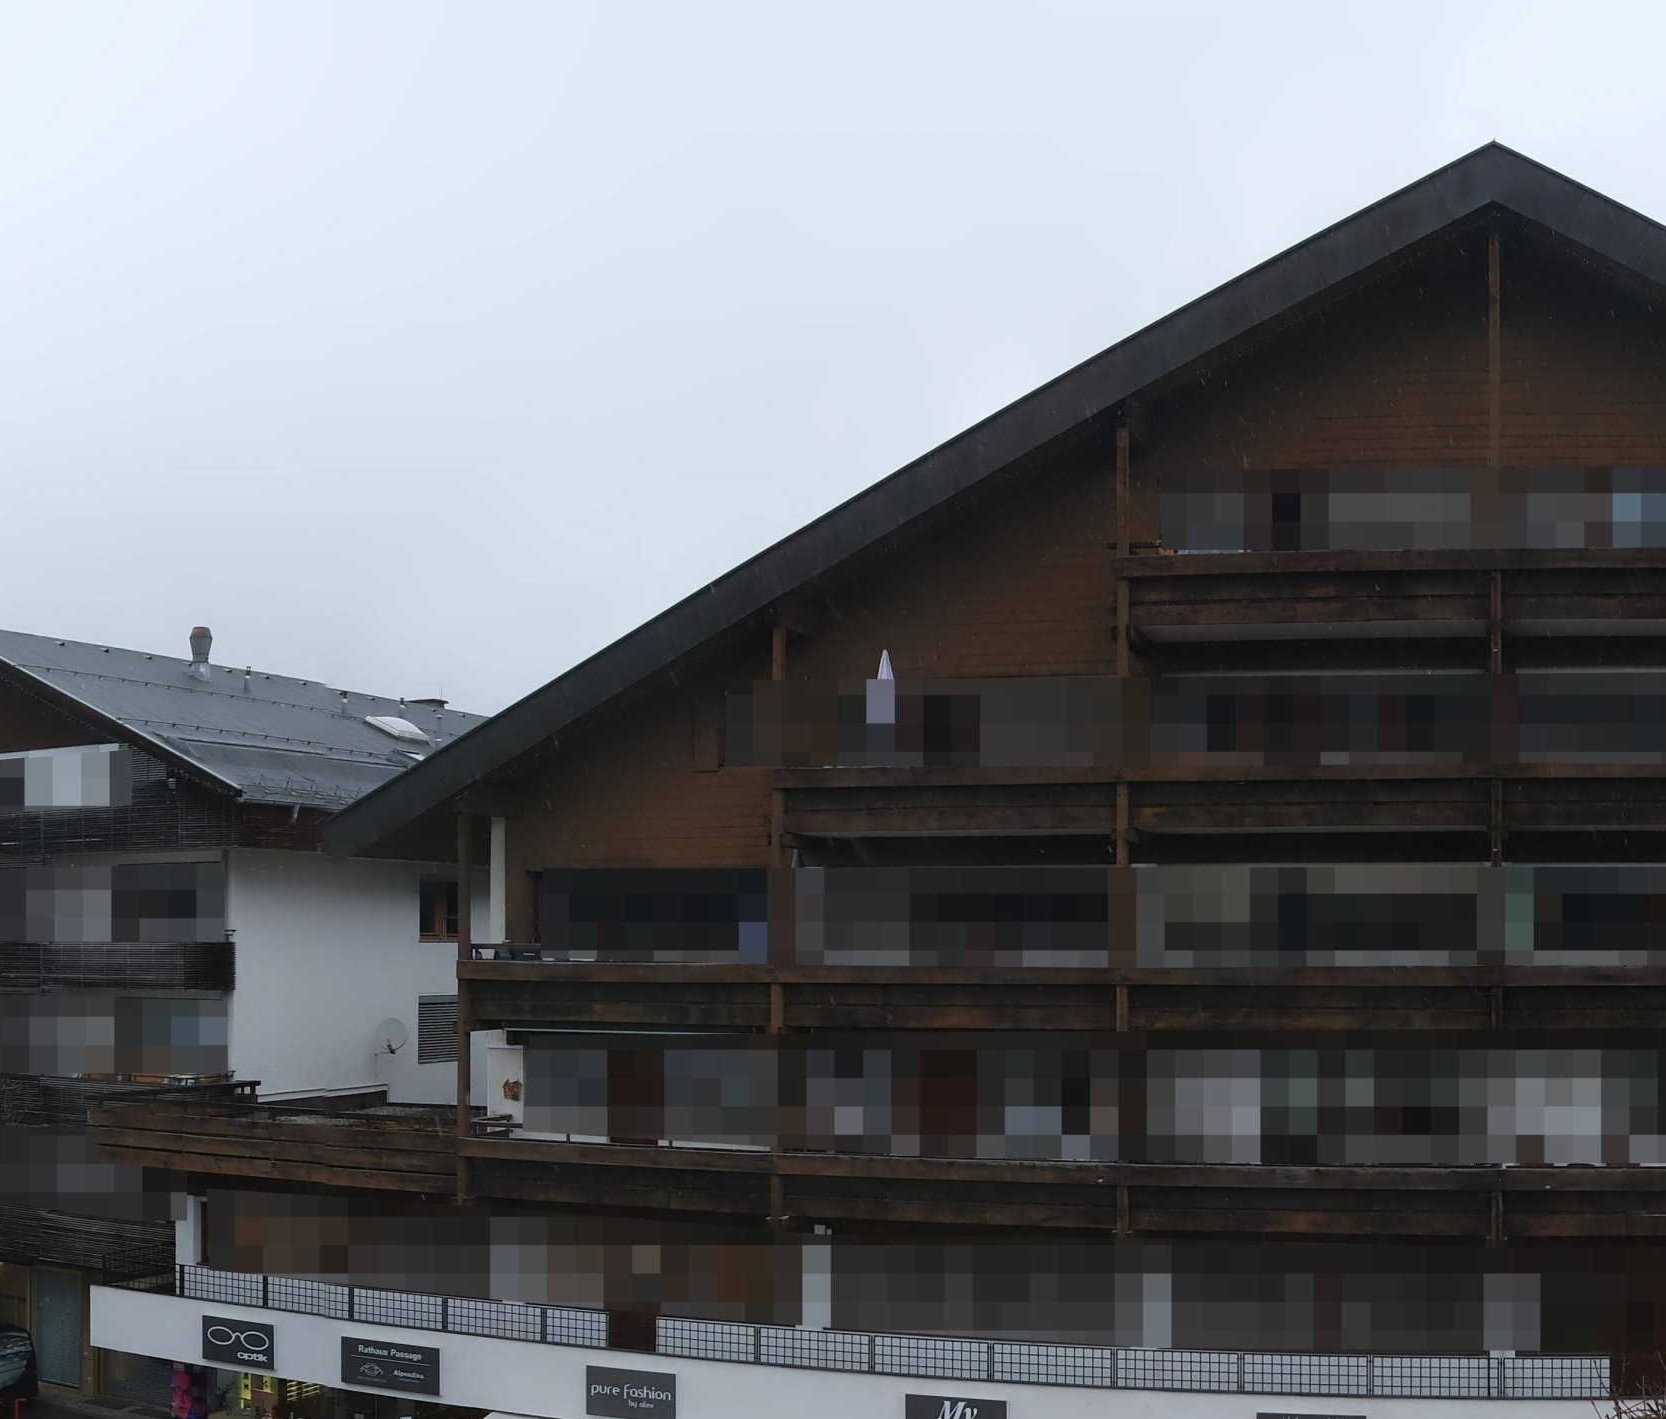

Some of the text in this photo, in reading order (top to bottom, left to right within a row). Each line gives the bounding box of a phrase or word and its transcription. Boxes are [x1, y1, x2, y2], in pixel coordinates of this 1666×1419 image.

[237, 1351, 268, 1363] optik
[358, 1344, 422, 1361] Rathaus Passage
[591, 1383, 672, 1401] pure fashion
[628, 1400, 654, 1409] by alex
